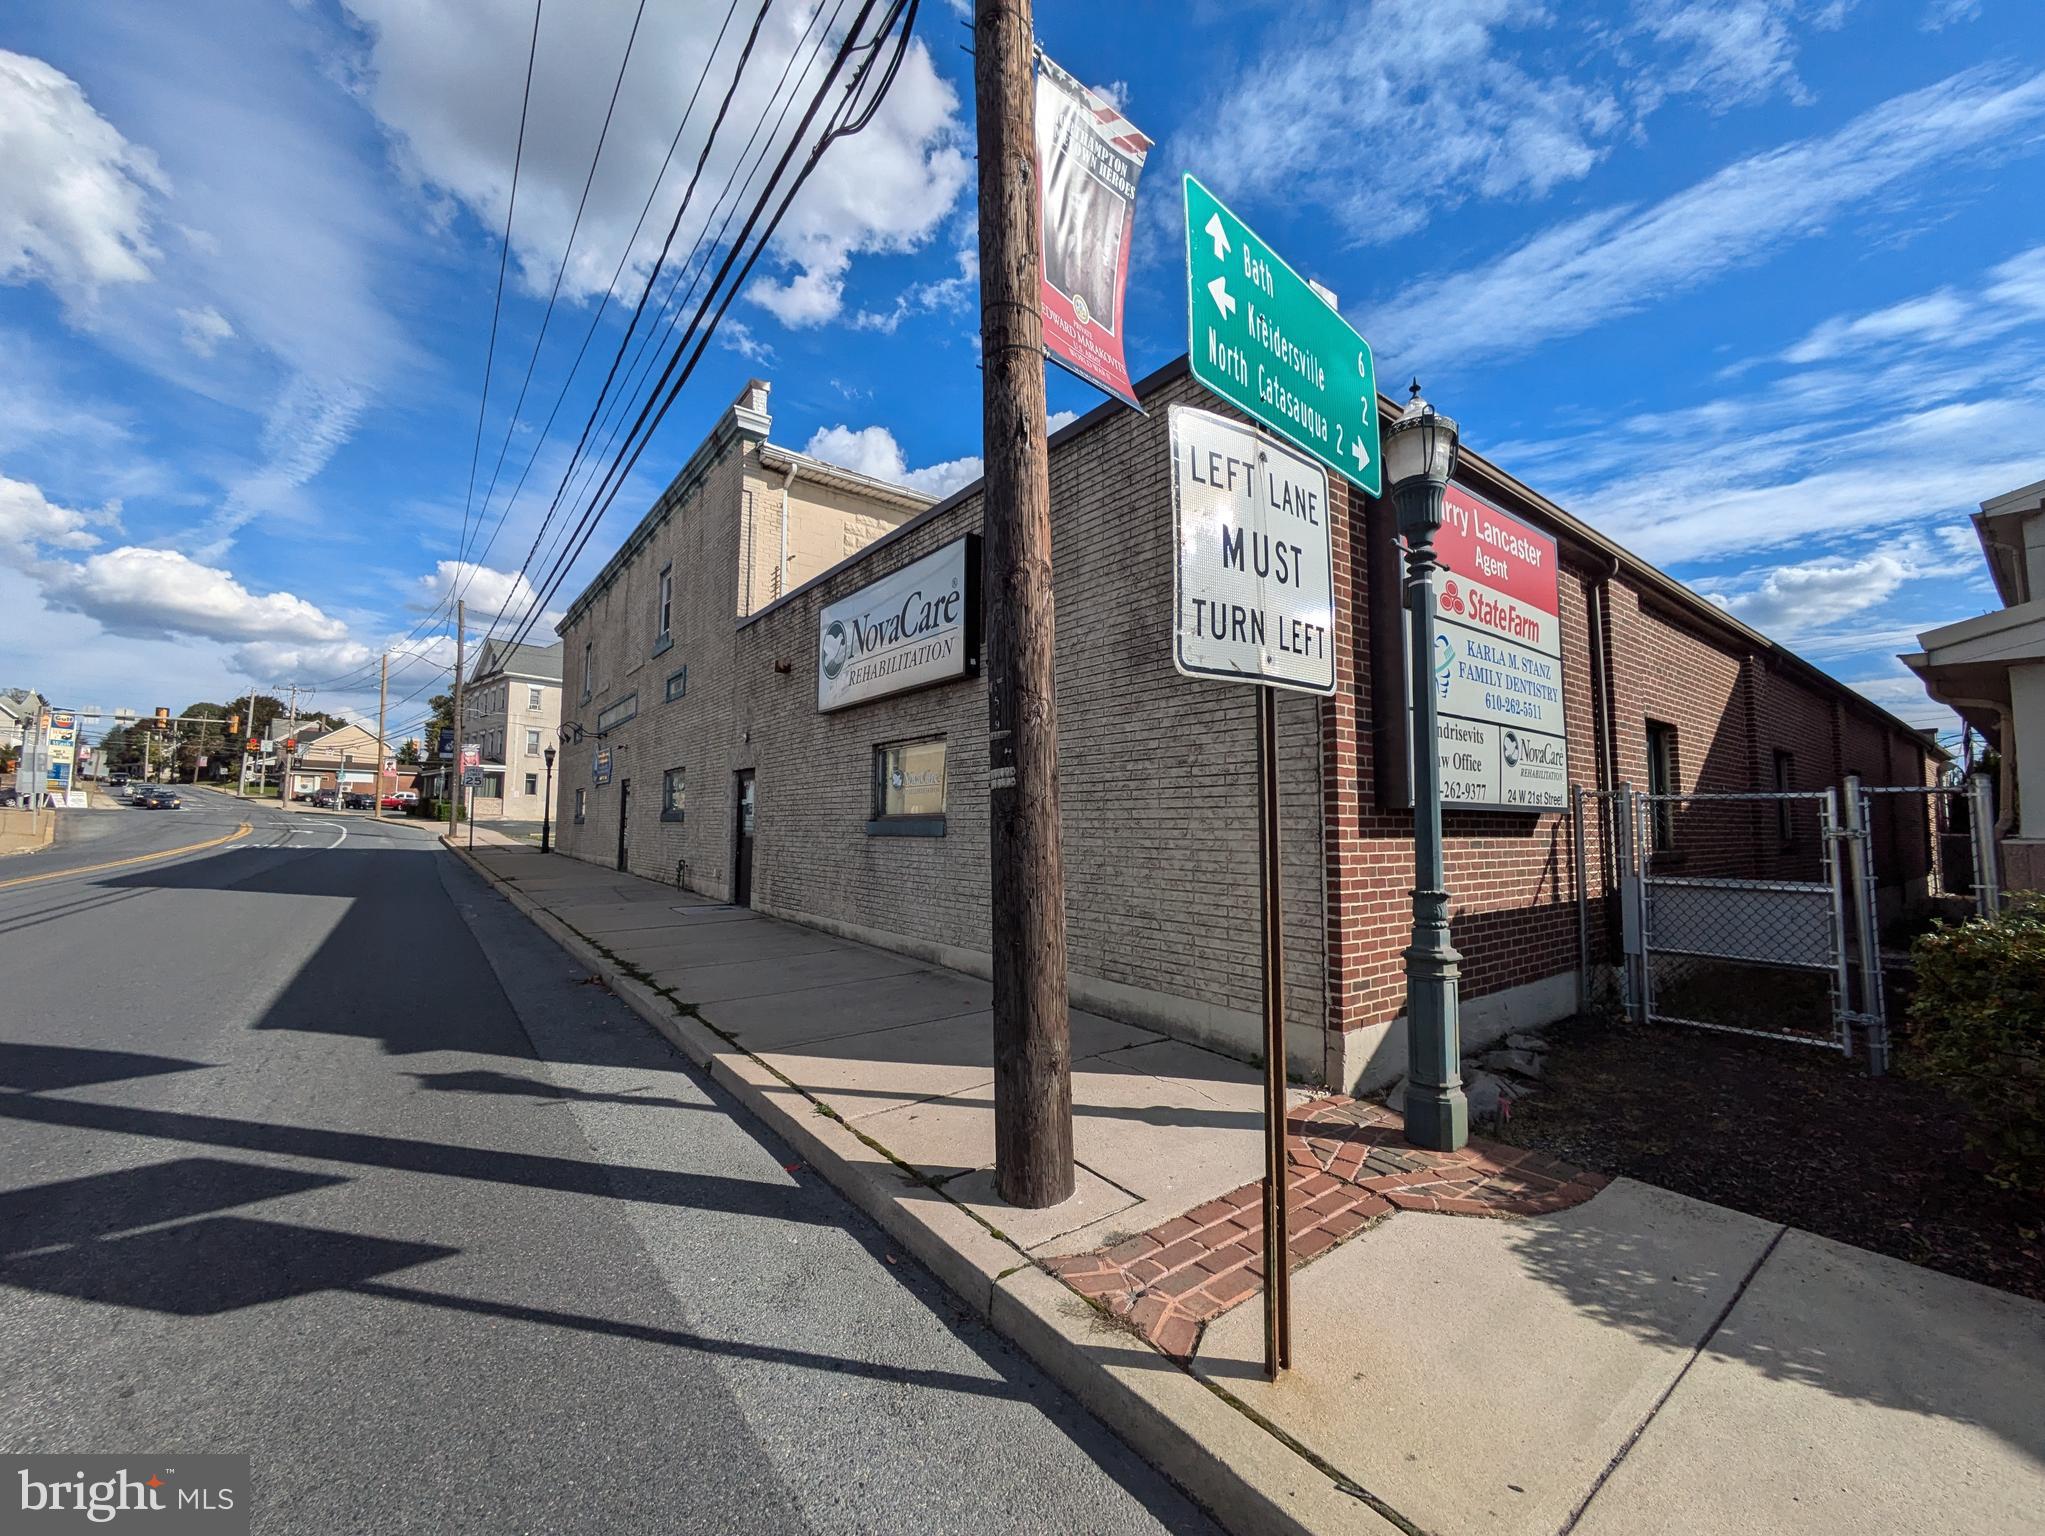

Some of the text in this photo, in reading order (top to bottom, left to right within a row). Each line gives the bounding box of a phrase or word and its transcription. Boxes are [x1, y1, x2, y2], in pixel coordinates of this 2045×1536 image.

[1099, 161, 1136, 200] HEROES
[1041, 301, 1077, 339] EDWARD
[1243, 243, 1365, 378] Bath 6
[1069, 347, 1093, 368] WORLD
[1247, 301, 1369, 427] Kreidersville 2
[1208, 325, 1344, 456] North Catasauqua 2
[1191, 445, 1319, 526] LEFT LANE
[1441, 501, 1542, 568] rry Lancaster
[1222, 523, 1302, 588] MUST
[1475, 545, 1509, 581] Agent
[848, 590, 960, 660] NovaCare
[1192, 598, 1324, 659] TURN LEFT
[849, 637, 955, 687] REHABILITATION
[1466, 639, 1552, 681] KARLA M. STANZ
[1458, 660, 1558, 703] FAMILY DENTISTRY
[1485, 692, 1542, 720] 610-262-5511
[1437, 722, 1484, 745] ndrisevits
[1519, 738, 1564, 767] NovaCare
[465, 776, 482, 785] 25
[1452, 752, 1482, 772] Office
[1520, 768, 1563, 781] REHABILITATION
[1439, 781, 1487, 801] -262-9377
[1507, 789, 1563, 807] 24 W 21st Street
